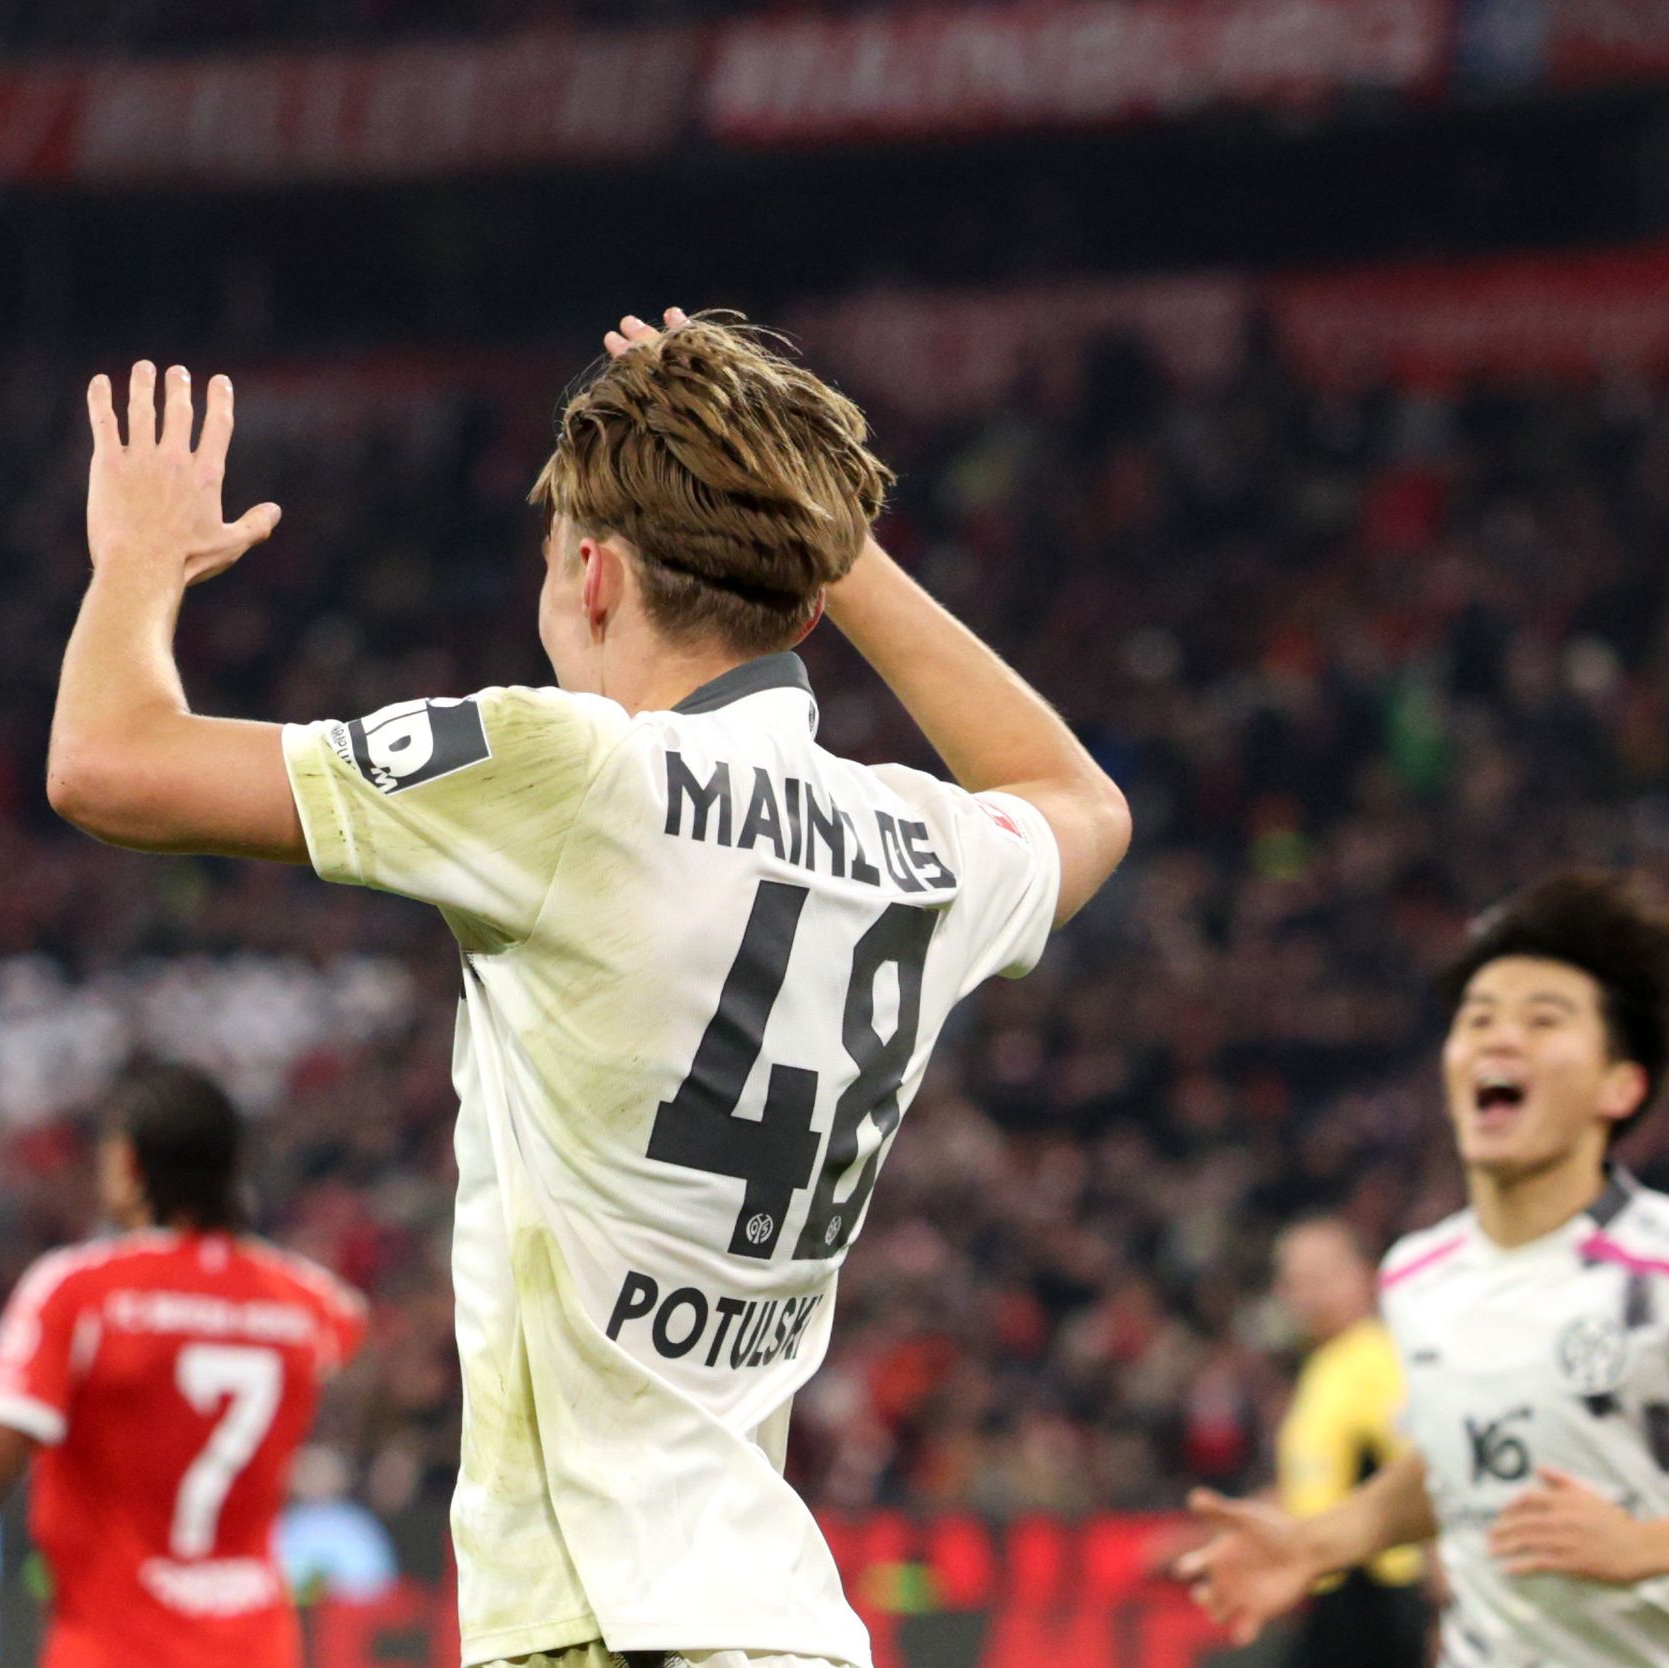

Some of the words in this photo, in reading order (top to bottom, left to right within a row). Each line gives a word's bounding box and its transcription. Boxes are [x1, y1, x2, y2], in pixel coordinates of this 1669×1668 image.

[645, 880, 936, 1261] 48
[605, 1270, 825, 1370] POTULSK
[174, 1343, 284, 1559] 7
